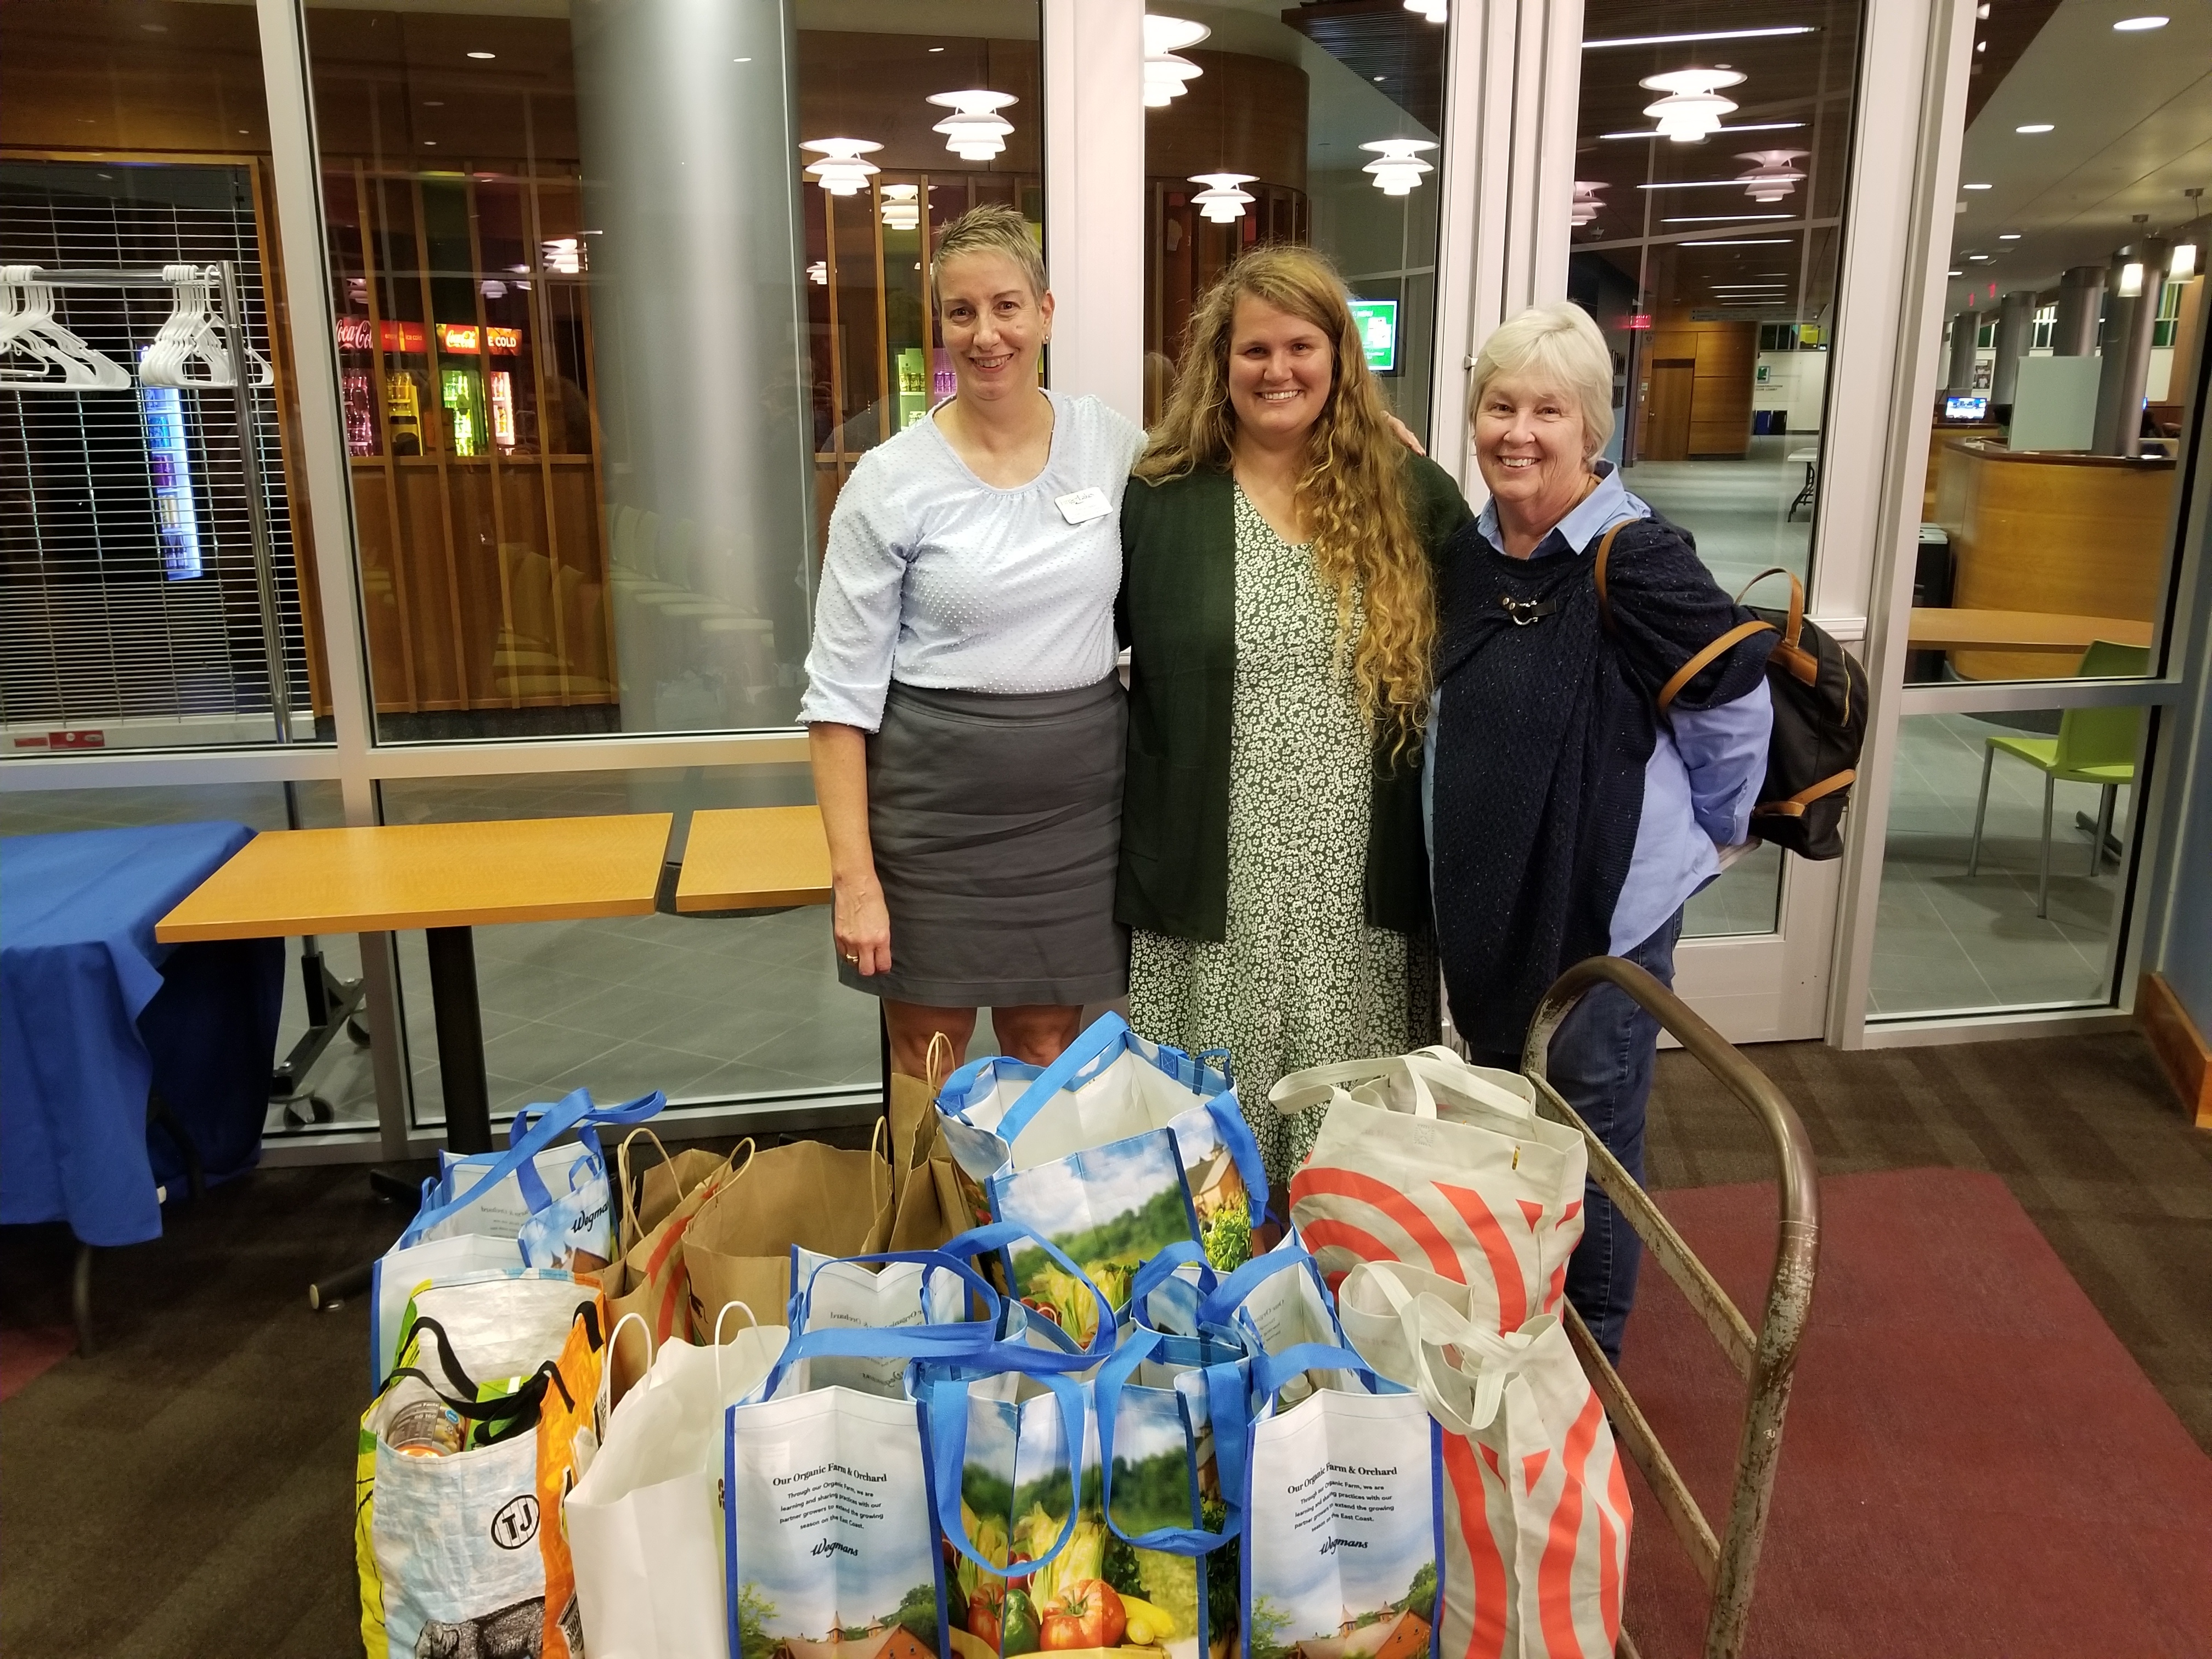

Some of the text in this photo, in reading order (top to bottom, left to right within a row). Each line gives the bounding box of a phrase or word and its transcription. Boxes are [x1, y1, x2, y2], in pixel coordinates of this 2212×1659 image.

[336, 319, 374, 349] Coca-Col
[495, 336, 516, 347] COLD
[793, 1465, 826, 1482] Organic
[828, 1463, 846, 1474] Farm
[848, 1467, 852, 1476] &
[854, 1469, 887, 1482] Orchard
[1288, 1462, 1397, 1494] Our Organic Farm & Orchard
[788, 1487, 810, 1498] Through
[844, 1483, 855, 1493] Farm,
[1301, 1491, 1317, 1504] Through
[781, 1502, 804, 1511] learning
[1295, 1505, 1314, 1517] learning
[502, 1504, 532, 1540] TJ
[780, 1514, 802, 1523] partner
[800, 1521, 820, 1529] season
[849, 1520, 864, 1529] Coast.
[1295, 1517, 1312, 1530] partner
[1311, 1521, 1325, 1532] season
[810, 1538, 859, 1558] Wegmans
[1319, 1536, 1368, 1555] Wegmans
